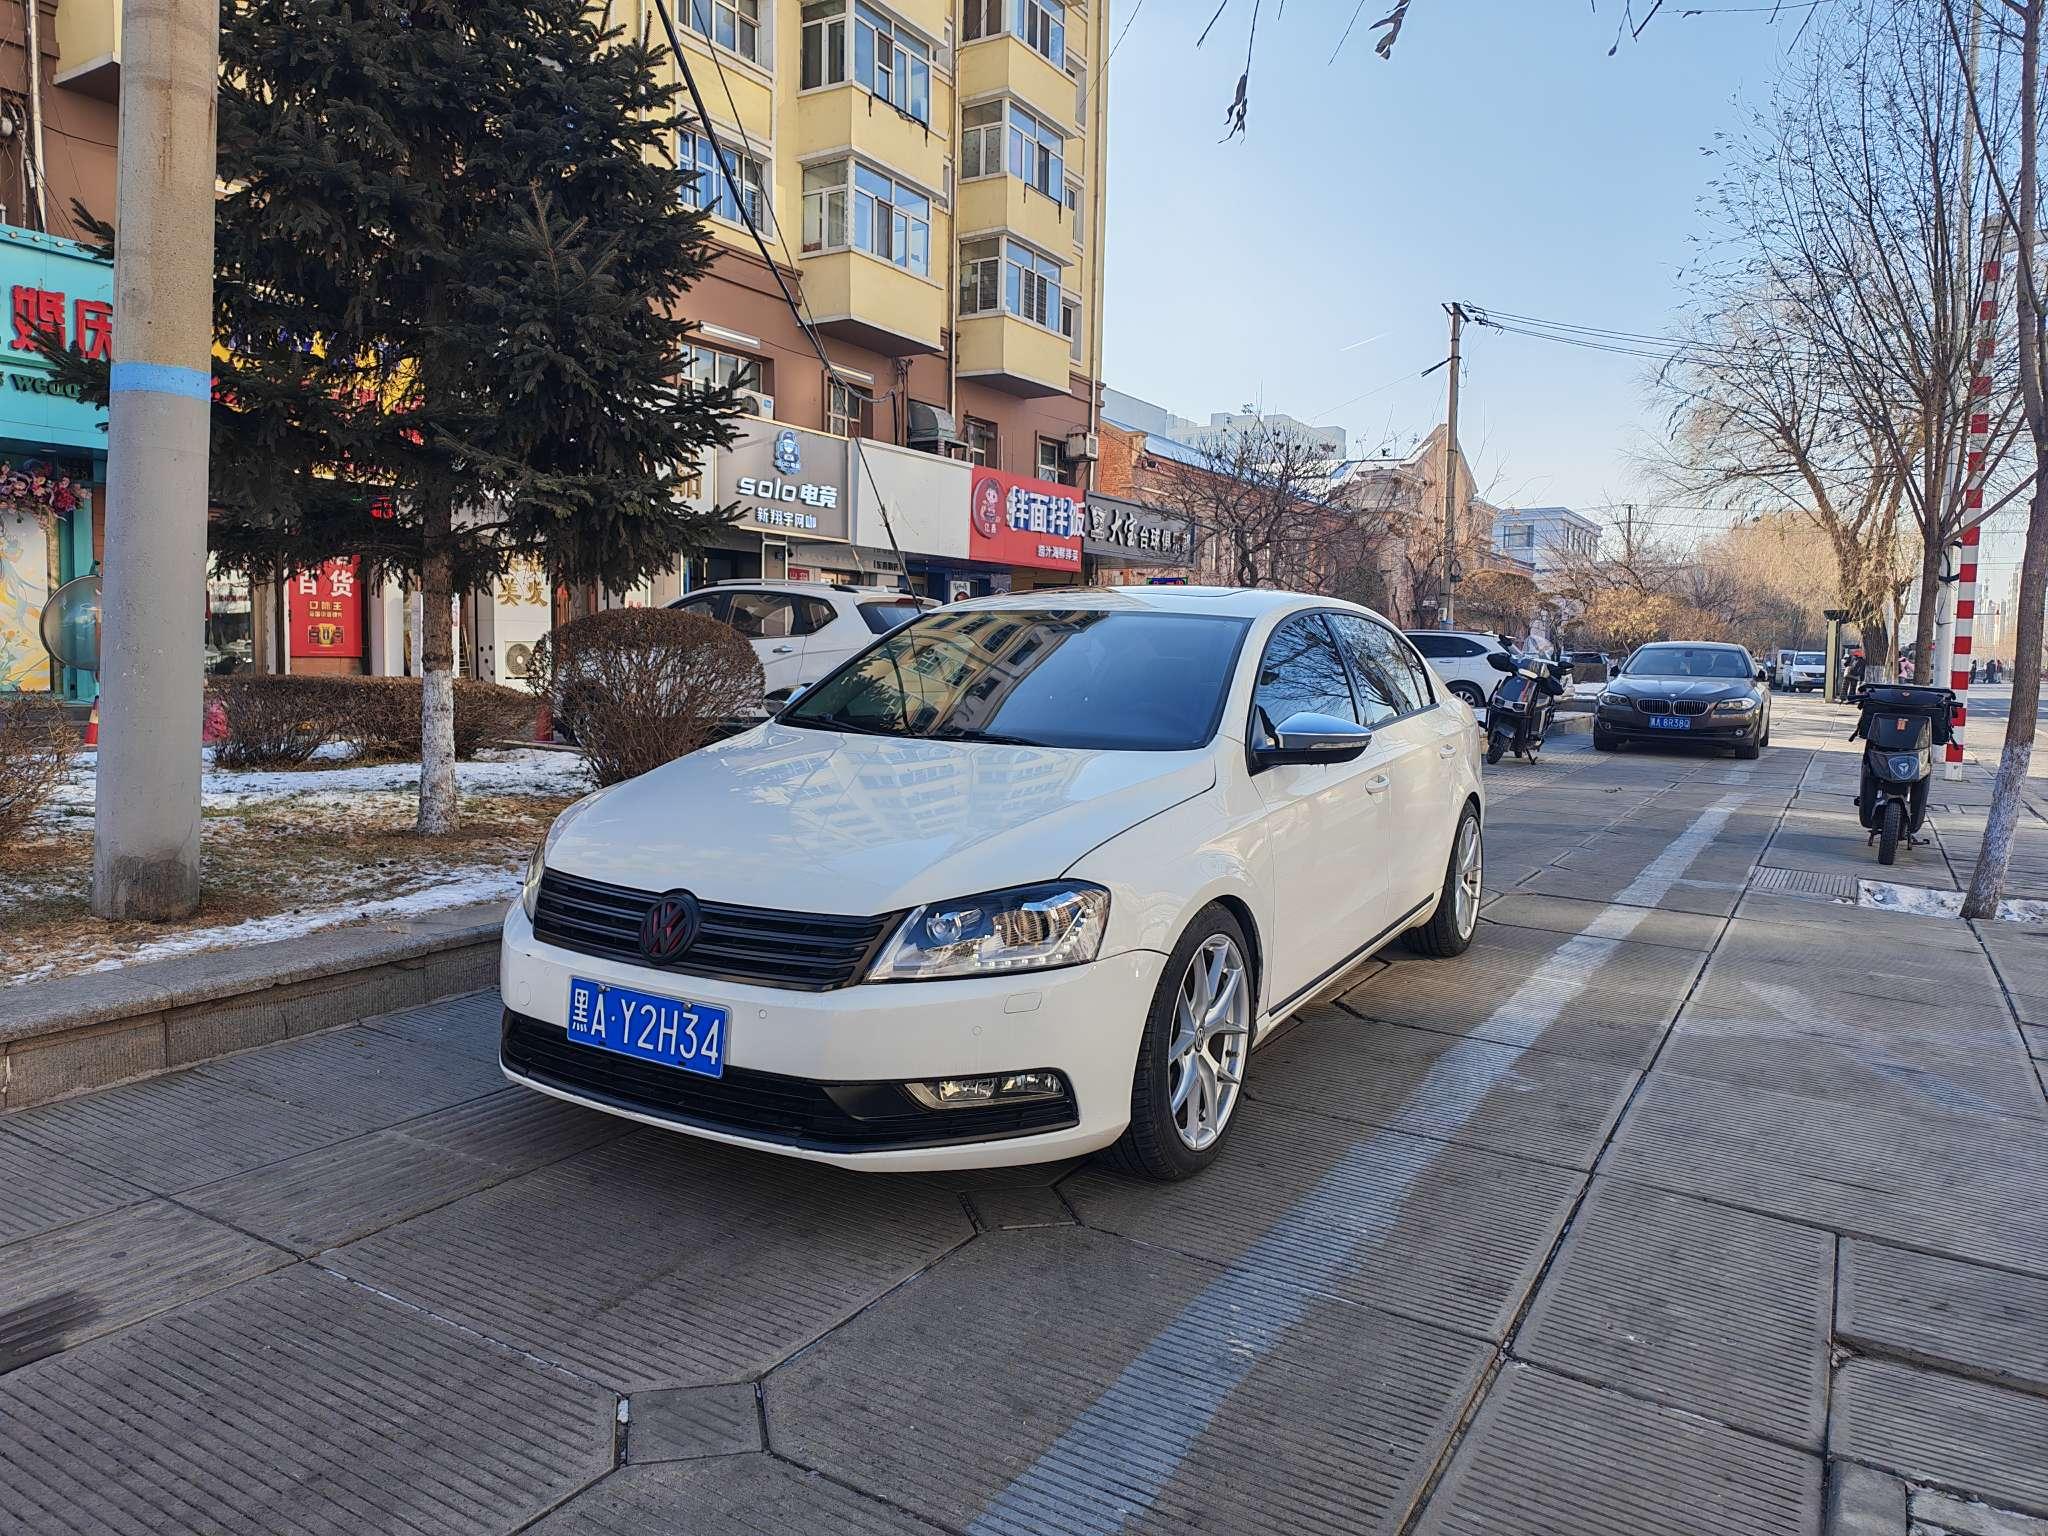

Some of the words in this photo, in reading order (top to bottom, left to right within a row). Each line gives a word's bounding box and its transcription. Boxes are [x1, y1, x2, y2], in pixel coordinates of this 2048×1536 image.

[737, 476, 797, 503] solo
[800, 483, 838, 509] 电竞
[1006, 485, 1086, 539] 拌面拌饭
